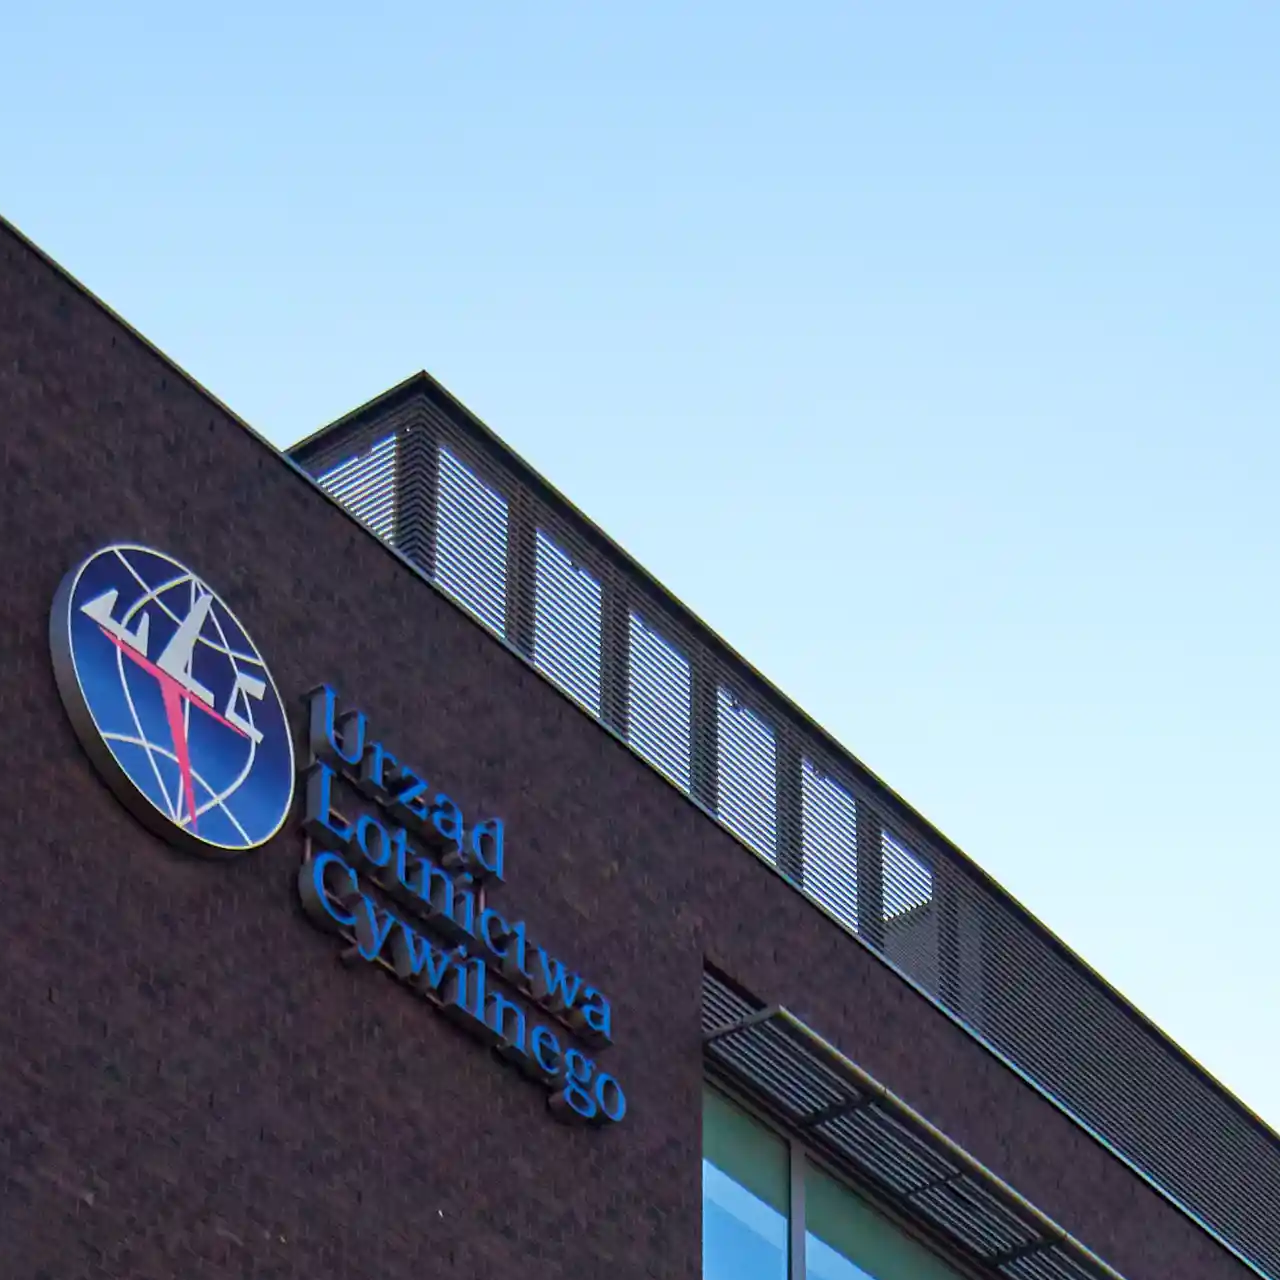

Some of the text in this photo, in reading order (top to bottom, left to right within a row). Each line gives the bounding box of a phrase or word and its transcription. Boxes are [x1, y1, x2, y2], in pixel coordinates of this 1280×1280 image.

[318, 760, 612, 1040] Lotnictwa
[323, 683, 505, 883] Urząd
[312, 851, 626, 1122] Cywilnego
